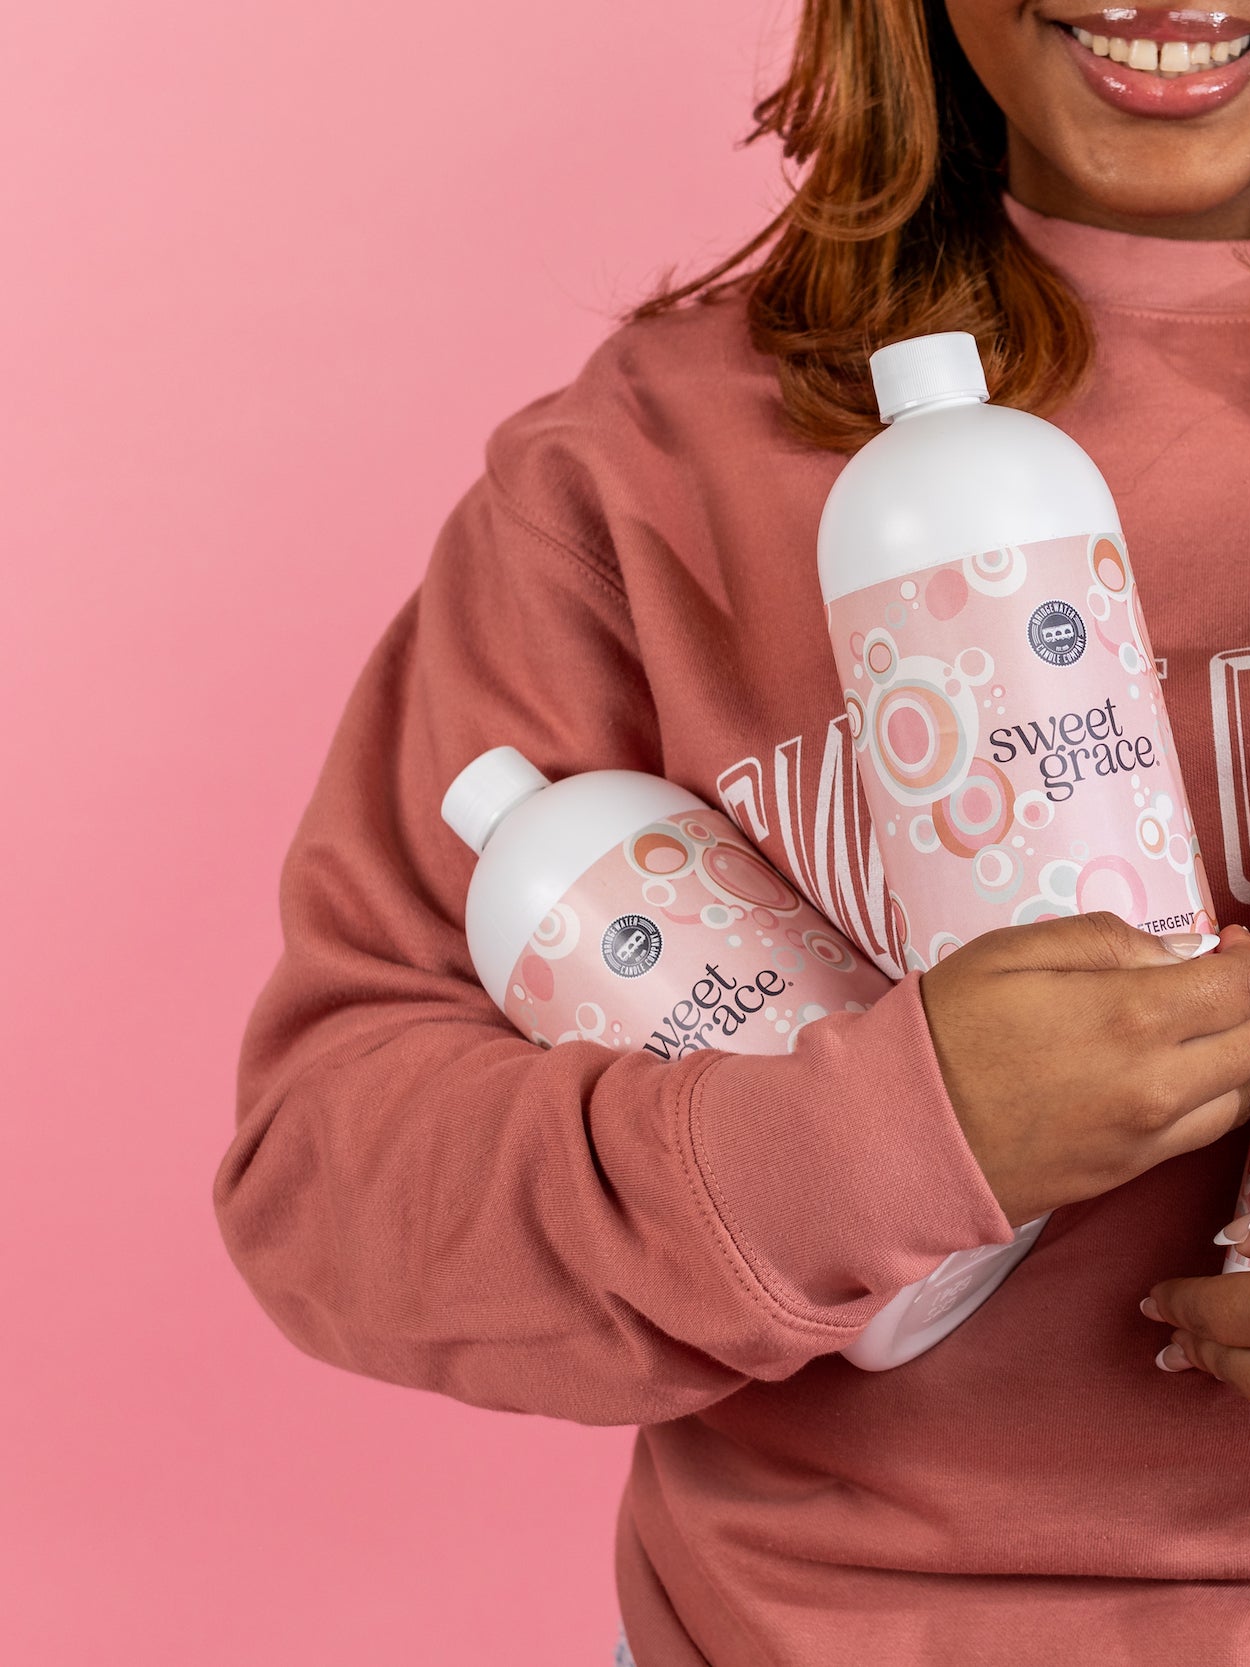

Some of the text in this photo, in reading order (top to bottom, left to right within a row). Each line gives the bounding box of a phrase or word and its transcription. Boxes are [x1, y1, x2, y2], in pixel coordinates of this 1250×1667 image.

[1032, 603, 1076, 625] BRIDGEWATER
[1036, 637, 1085, 664] CANDLE COMPANY
[989, 697, 1124, 763] sweet
[604, 917, 638, 954] BRIDGEWATER
[620, 963, 645, 975] CANDLE
[644, 933, 660, 966] COMPANY
[642, 963, 737, 1061] weet
